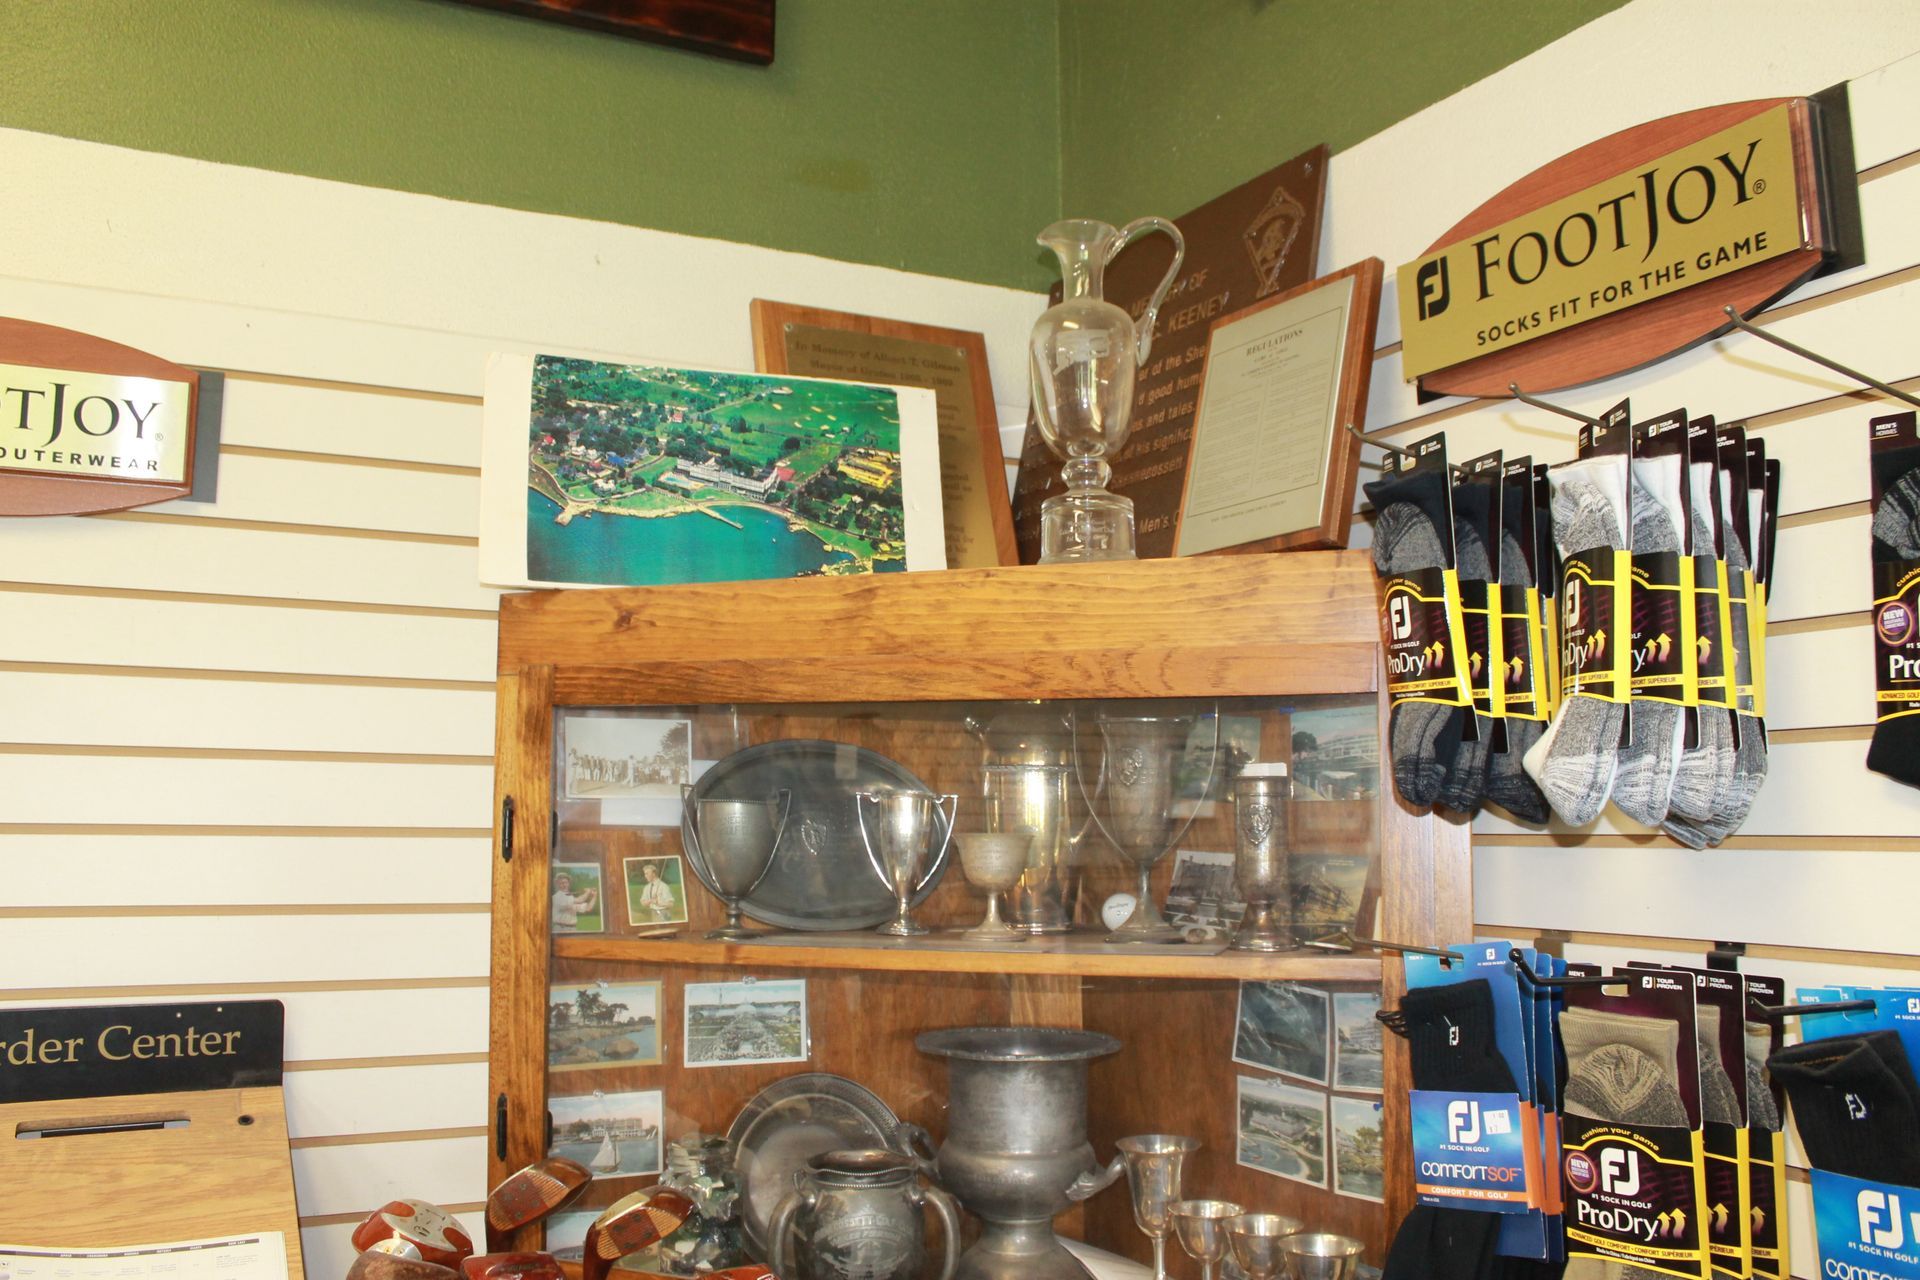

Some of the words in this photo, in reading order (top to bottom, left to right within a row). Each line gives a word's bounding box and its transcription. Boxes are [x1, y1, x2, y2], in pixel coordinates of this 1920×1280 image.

[1471, 138, 1763, 302] FOOTJOY
[1476, 311, 1541, 346] SOCKS
[1549, 299, 1581, 323] FIT
[1590, 280, 1634, 309] FOR
[1639, 259, 1686, 291] THE
[1696, 231, 1769, 271] GAME
[0, 381, 161, 447] TJOY
[1140, 514, 1170, 534] Men's
[1390, 595, 1412, 640] FJ
[1883, 608, 1905, 620] NEW
[97, 1025, 241, 1060] Center
[1448, 1100, 1480, 1144] FJ
[1581, 1127, 1609, 1140] cushion
[1611, 1127, 1631, 1136] your
[1633, 1133, 1660, 1151] game
[1600, 1147, 1640, 1196] FJ
[1431, 1186, 1465, 1196] COMFORT
[1469, 1188, 1484, 1198] FOR
[1487, 1191, 1509, 1200] GOLF
[1600, 1195, 1620, 1205] SOCK
[1621, 1198, 1630, 1206] IN
[1631, 1200, 1652, 1210] GOLF
[1577, 1198, 1659, 1241] ProDry
[1857, 1189, 1904, 1249] FJ
[1607, 1239, 1631, 1250] COMFORT
[1634, 1247, 1660, 1256] CONFORT
[1859, 1244, 1882, 1257] SOCK
[1883, 1250, 1893, 1259] IN
[1895, 1253, 1918, 1264] GOLF
